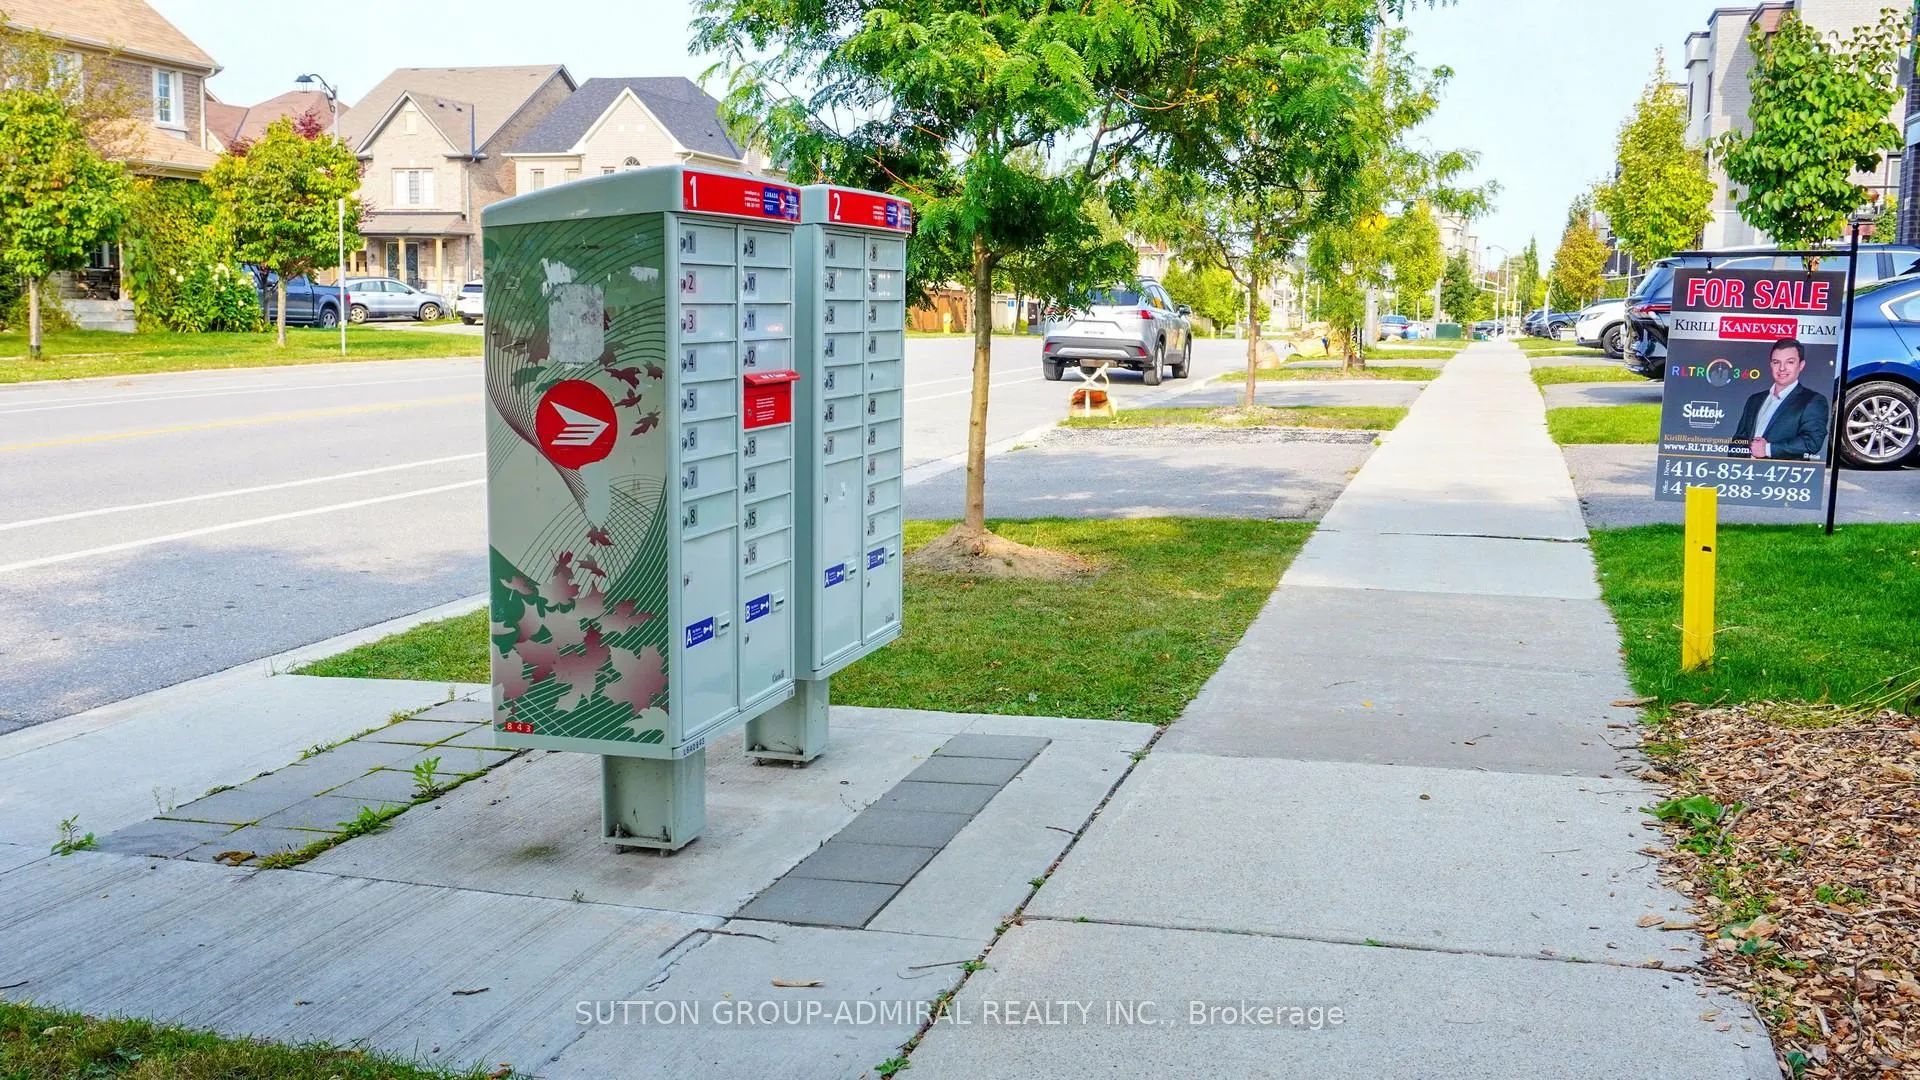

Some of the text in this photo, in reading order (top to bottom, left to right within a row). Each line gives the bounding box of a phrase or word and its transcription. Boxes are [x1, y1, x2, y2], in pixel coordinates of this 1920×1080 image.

[690, 176, 697, 207] 1
[833, 193, 841, 220] 2
[689, 235, 693, 250] 1
[748, 239, 753, 254] 9
[689, 275, 693, 290] 2
[1687, 278, 1829, 310] FOR SALE
[689, 314, 694, 329] 3
[748, 311, 755, 327] 11
[1675, 319, 1836, 336] KIRILL KANEVSKY TEAM
[689, 353, 694, 368] 4
[748, 349, 755, 364] 12
[689, 392, 695, 407] 5
[1682, 404, 1725, 418] Sutton
[689, 432, 695, 446] 6
[1664, 434, 1749, 445] KirillRealtor@gmail.com
[748, 440, 756, 455] 13
[690, 470, 695, 485] 7
[1671, 461, 1816, 484] 416-854-4757
[748, 476, 756, 490] 14
[690, 509, 696, 523] 8
[748, 511, 756, 526] 15
[748, 546, 756, 561] 16
[745, 605, 751, 620] B
[686, 629, 692, 645] A
